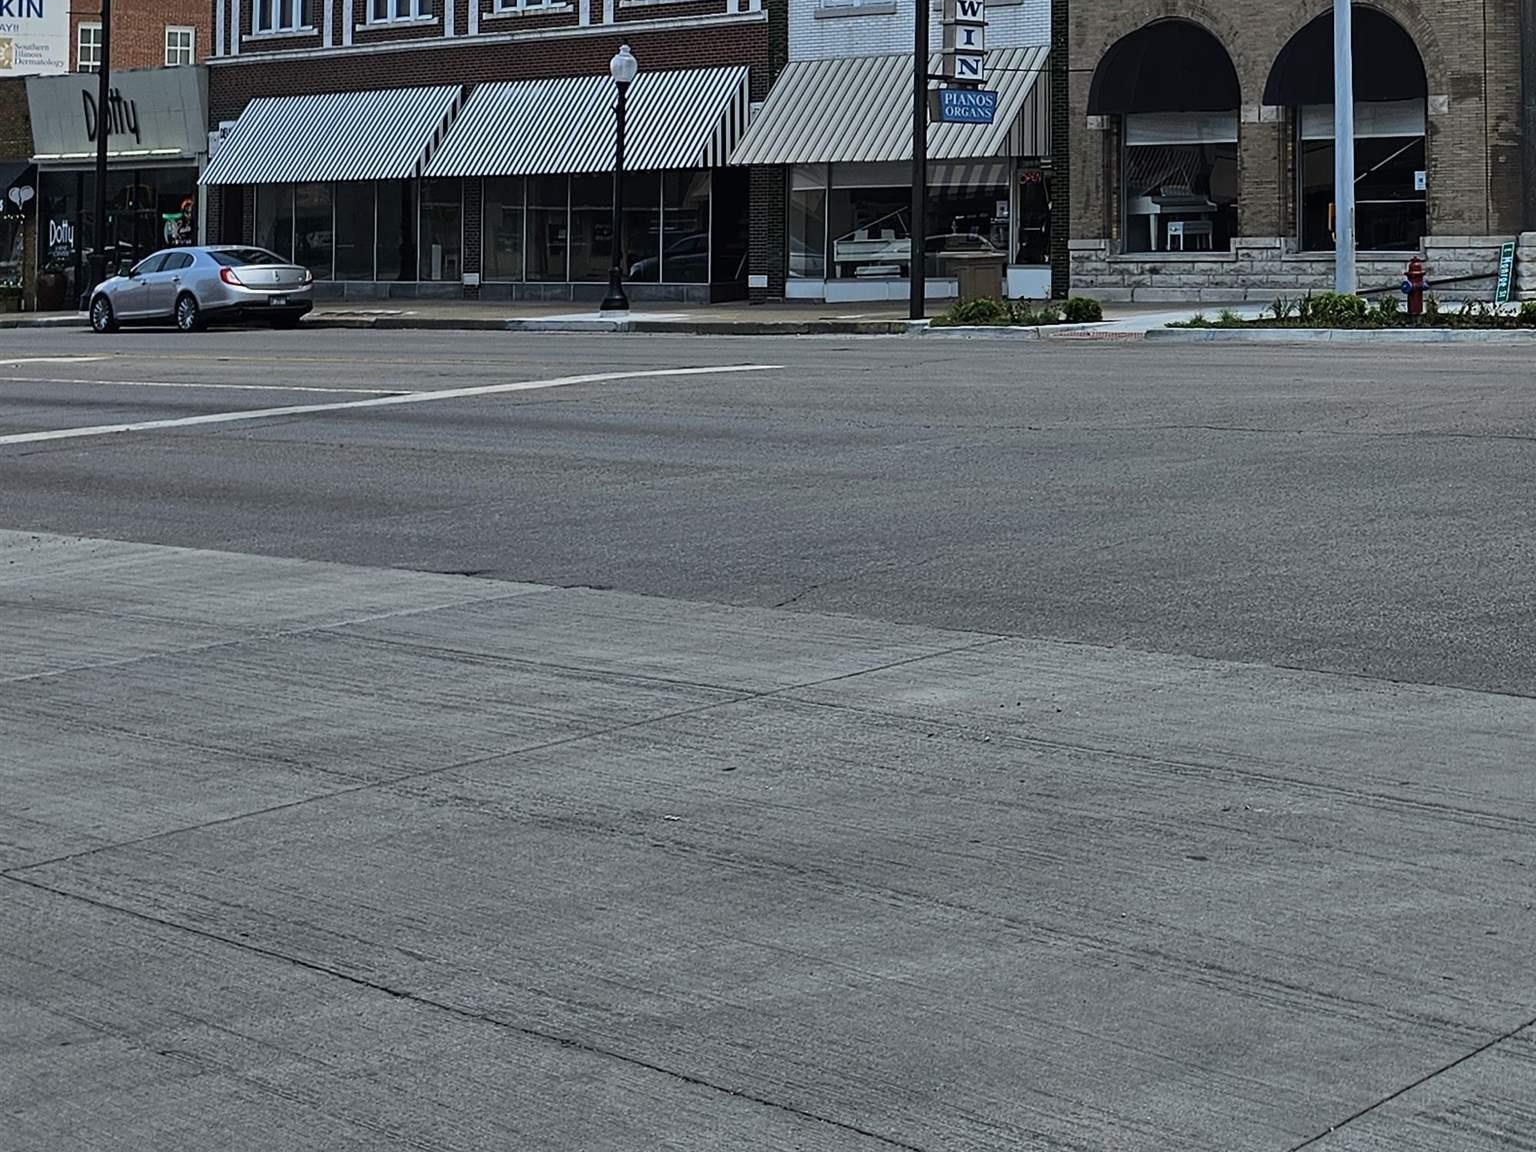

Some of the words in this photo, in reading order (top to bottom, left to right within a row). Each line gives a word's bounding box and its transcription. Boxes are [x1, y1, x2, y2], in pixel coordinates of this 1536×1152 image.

[945, 93, 994, 107] PIANOS
[945, 106, 993, 118] ORGANS
[49, 219, 75, 249] Dotty
